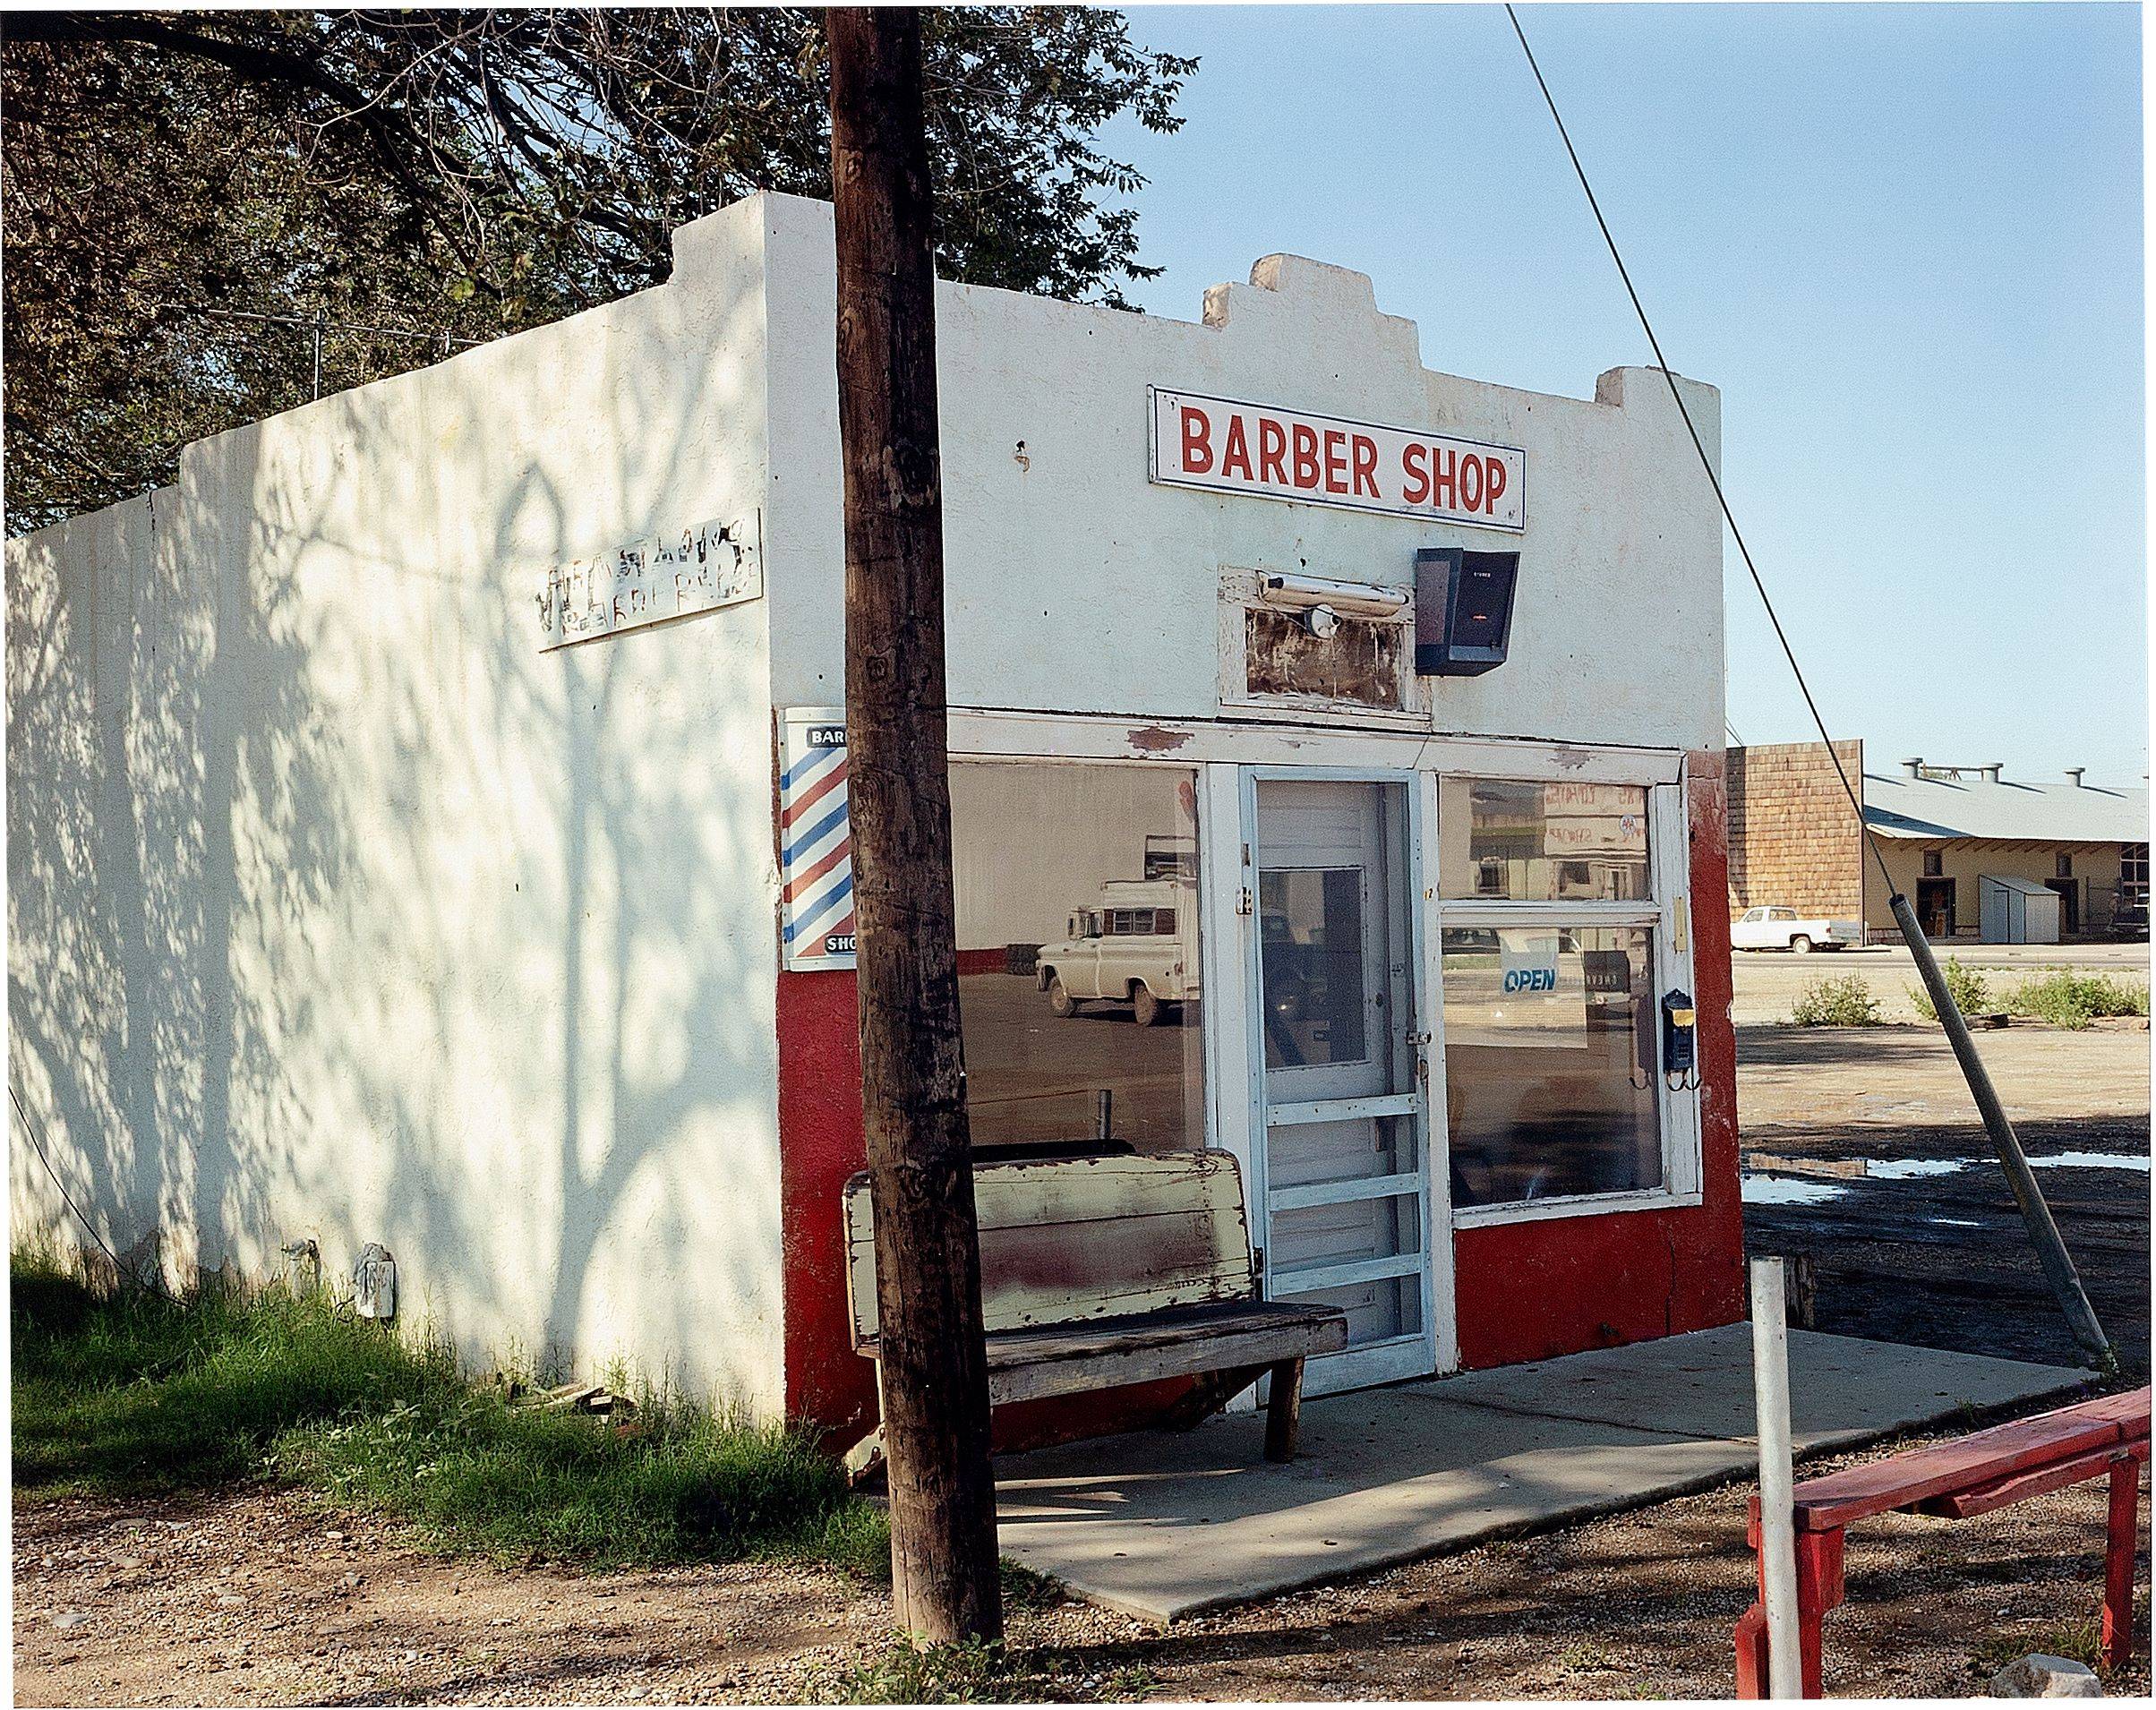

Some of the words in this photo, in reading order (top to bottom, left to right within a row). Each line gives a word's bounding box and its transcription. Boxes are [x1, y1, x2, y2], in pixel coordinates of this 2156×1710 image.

[1181, 406, 1382, 499] BARBER
[1402, 442, 1507, 515] SHOP
[811, 731, 848, 743] BAR
[827, 936, 856, 951] SHO
[1504, 969, 1555, 993] OPEN
